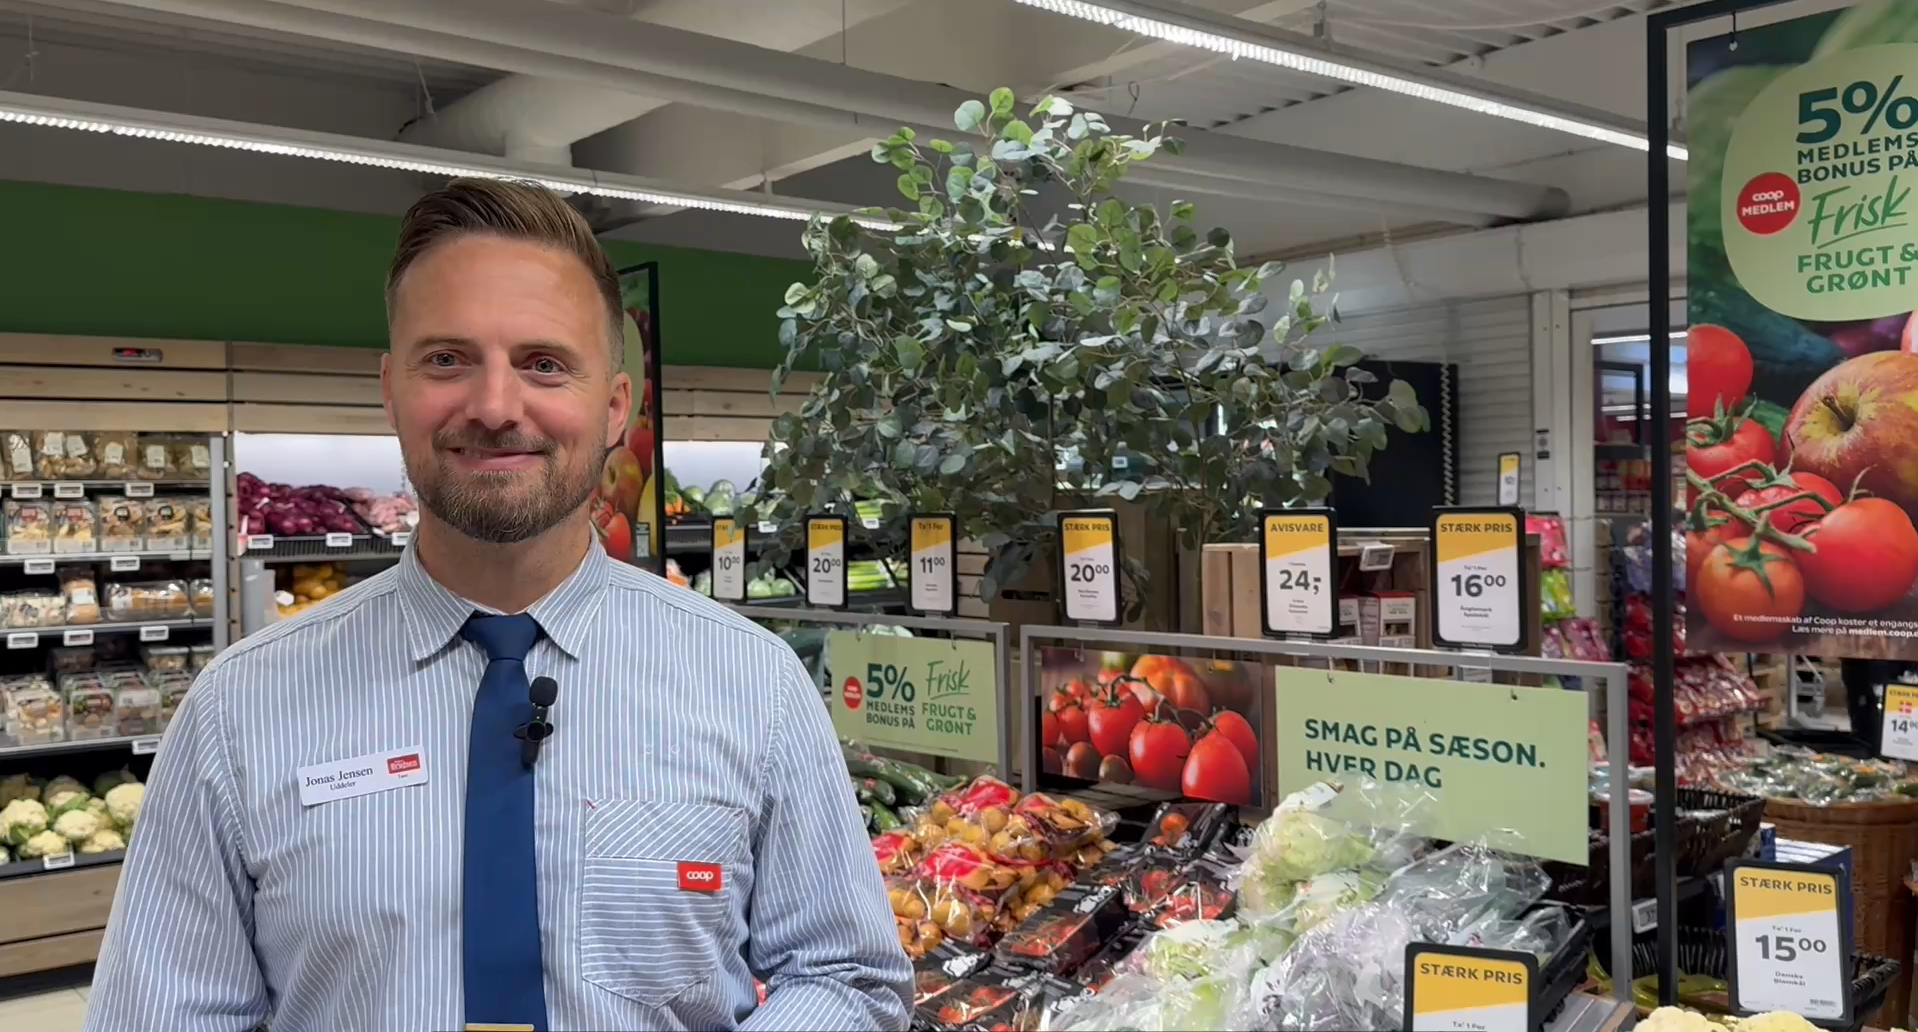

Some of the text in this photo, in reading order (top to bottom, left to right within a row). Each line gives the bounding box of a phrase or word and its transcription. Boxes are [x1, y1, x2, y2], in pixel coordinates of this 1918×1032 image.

[1796, 75, 1918, 144] 5%
[1797, 132, 1918, 166] MEDLEMS
[1798, 158, 1881, 184] BONUS
[1752, 190, 1785, 202] coop
[1741, 200, 1795, 217] MEDLEM
[1808, 175, 1911, 245] Frisk
[1797, 245, 1894, 274] FRUGT
[1806, 266, 1911, 294] GRØNT
[1064, 523, 1110, 531] STÆRK PRIS
[1270, 523, 1324, 532] AVISVARE
[1440, 523, 1513, 533] STÆRK PRIS
[1792, 625, 1809, 633] Læs
[1811, 627, 1834, 635] mere
[1835, 627, 1847, 636] på
[1803, 616, 1812, 624] af
[1813, 616, 1837, 625] Coop
[1838, 618, 1867, 627] koster
[1868, 619, 1878, 627] et
[866, 663, 915, 702] 5%
[925, 660, 970, 697] Frisk
[867, 701, 915, 716] MEDLEMS
[921, 702, 977, 720] FRUGT &
[867, 713, 915, 729] BONUS PÅ
[926, 719, 973, 735] GRØNT
[1304, 718, 1546, 768] SMAG PÅ SÆSON.
[305, 767, 374, 787] Jonas Jensen
[1384, 760, 1442, 788] DAG
[329, 781, 356, 791] Uddeler
[686, 870, 714, 882] coop
[1740, 877, 1832, 895] STÆRK PRIS
[1420, 963, 1523, 985] STÆRK PRIS
